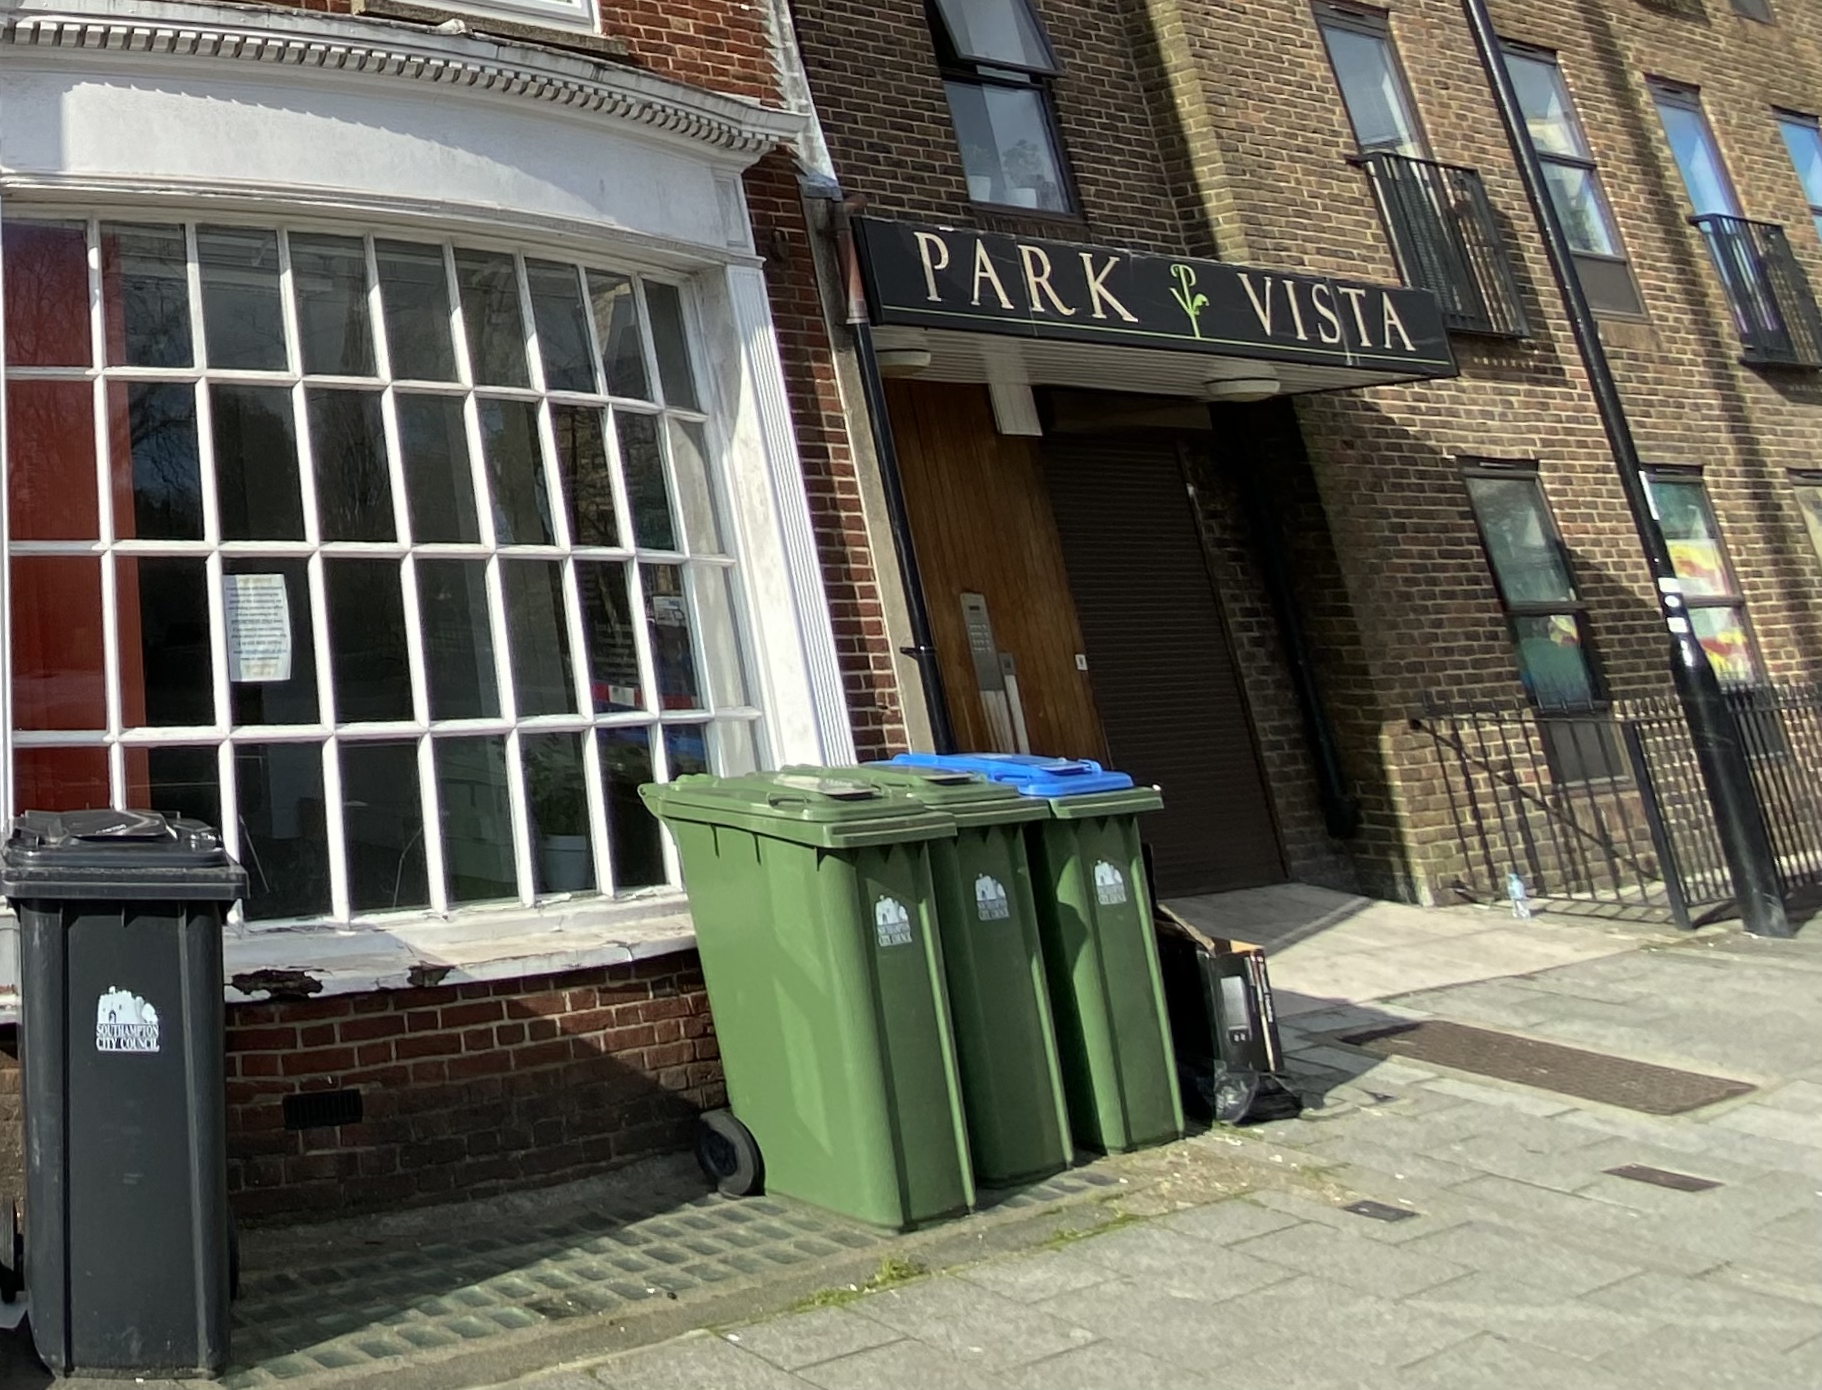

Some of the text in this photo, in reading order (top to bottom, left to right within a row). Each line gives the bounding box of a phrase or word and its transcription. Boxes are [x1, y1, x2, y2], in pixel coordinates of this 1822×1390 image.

[913, 230, 1417, 353] PARK VISTA
[96, 1023, 160, 1038] SOUTHAMPTON
[96, 1037, 160, 1050] CITY COUNCIL
